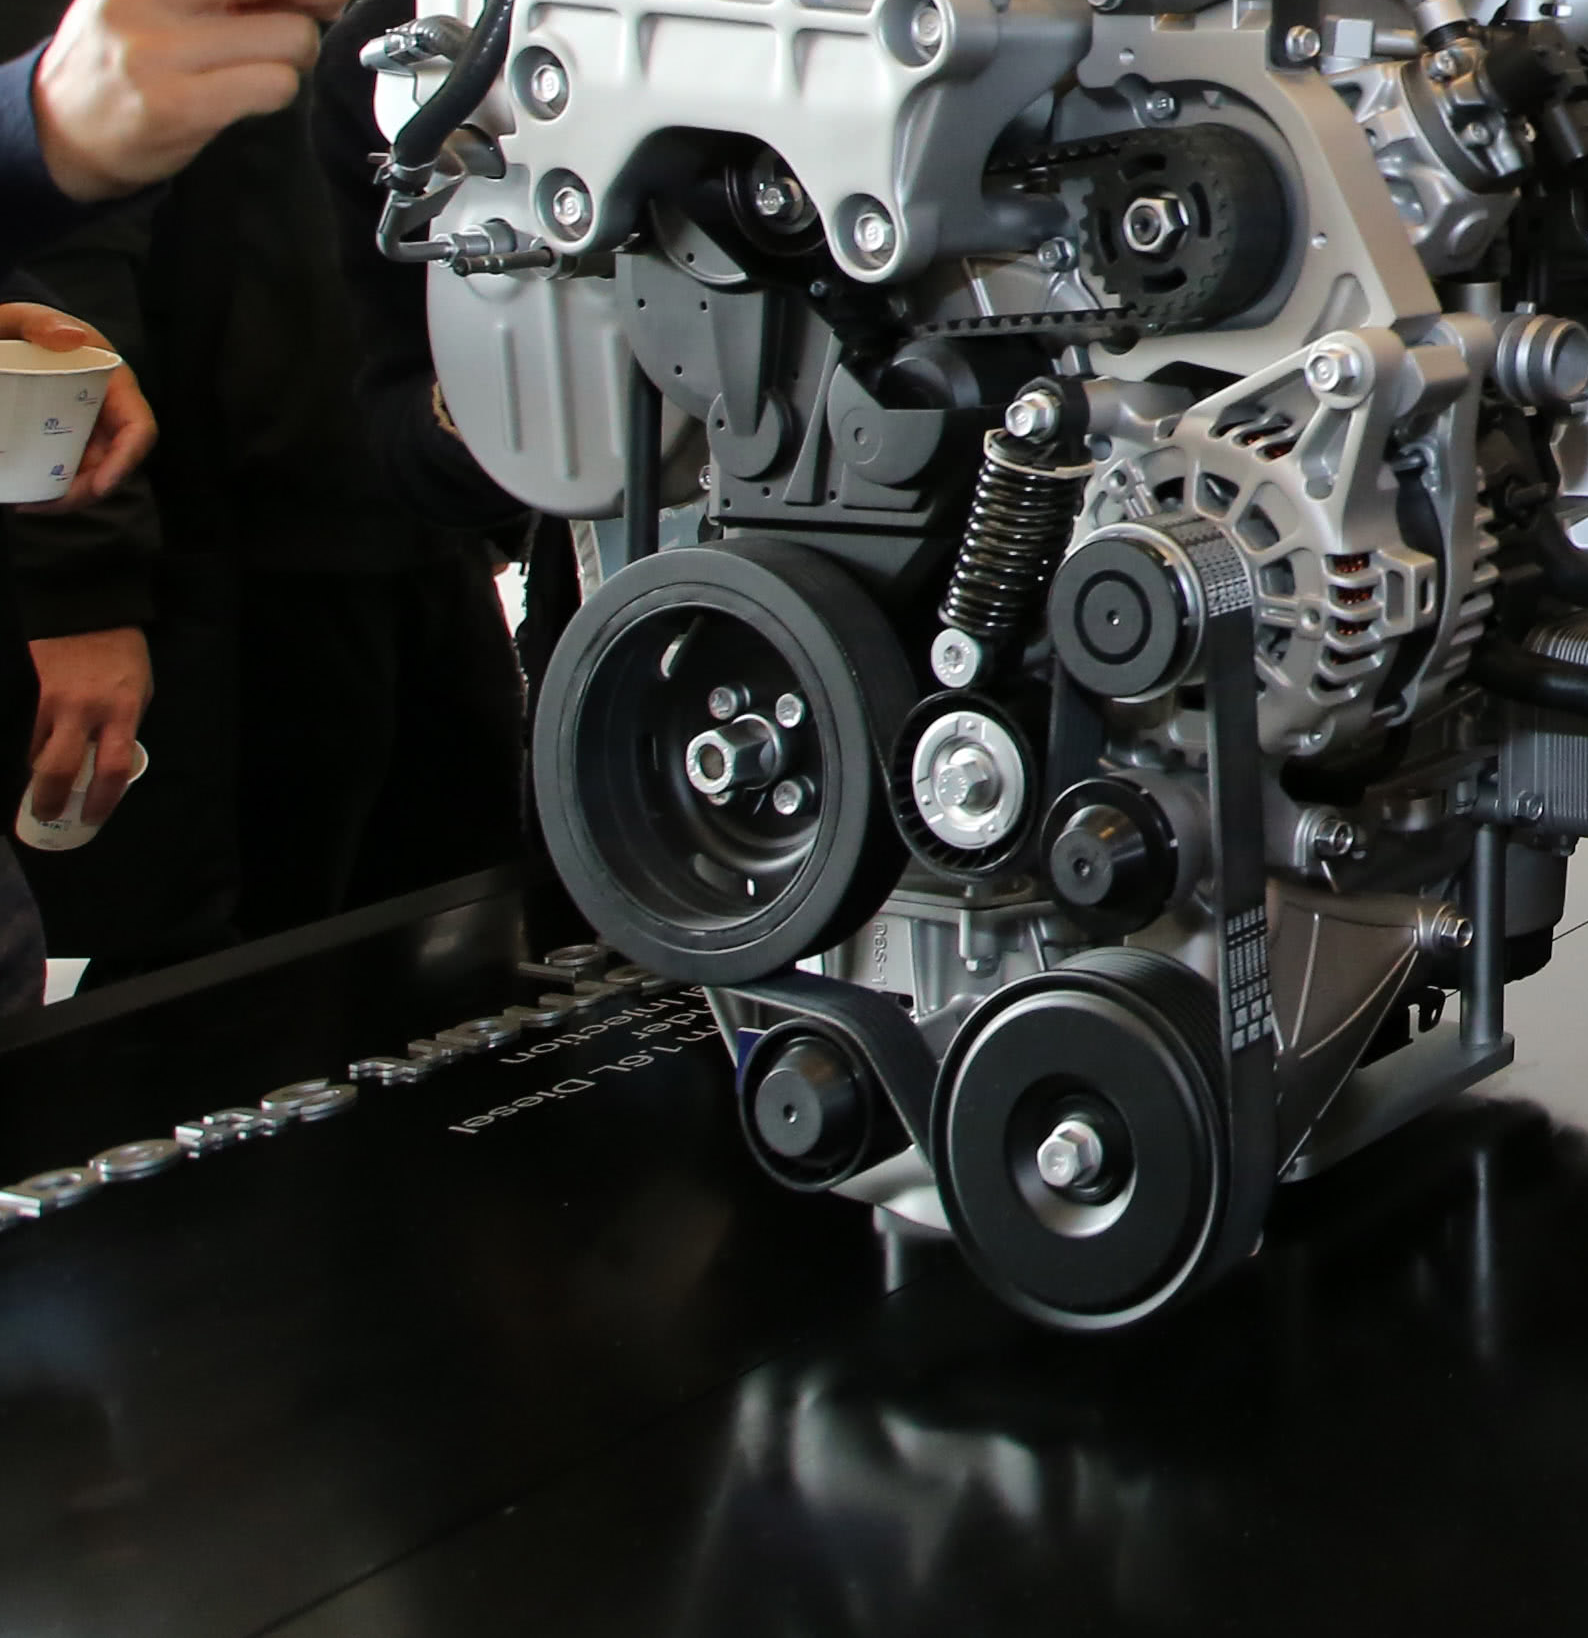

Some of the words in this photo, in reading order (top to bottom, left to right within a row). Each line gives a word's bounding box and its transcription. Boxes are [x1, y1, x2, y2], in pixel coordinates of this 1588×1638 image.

[500, 998, 685, 1064] Injection
[631, 1002, 713, 1040] nder
[588, 1046, 684, 1075] 1.6L
[448, 1079, 596, 1135] Diesel
